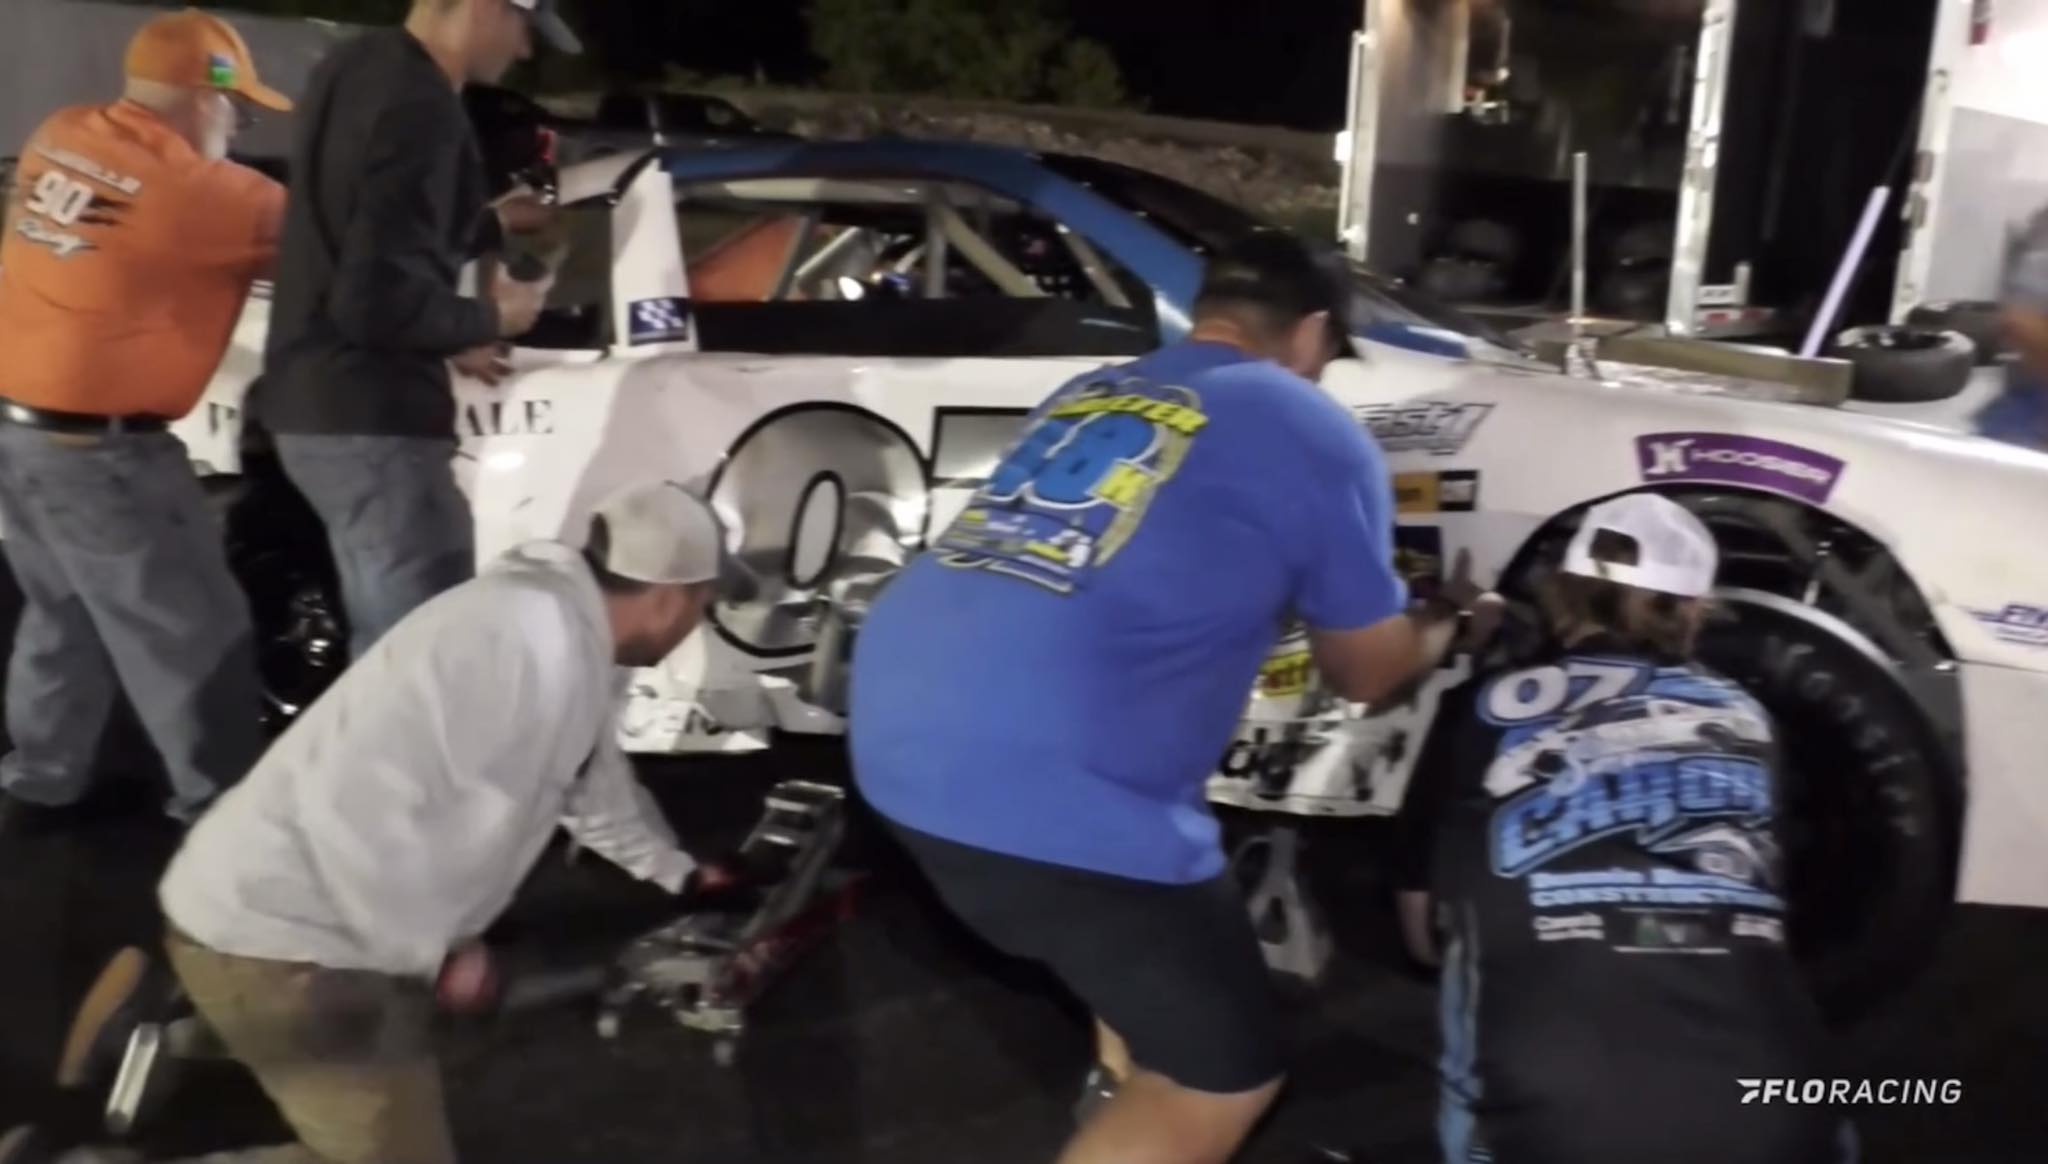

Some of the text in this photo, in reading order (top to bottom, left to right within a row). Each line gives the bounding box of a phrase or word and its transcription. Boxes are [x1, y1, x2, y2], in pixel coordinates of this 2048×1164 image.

[24, 169, 95, 227] 90
[1690, 448, 1833, 484] HOOSIER
[1486, 659, 1643, 722] 07
